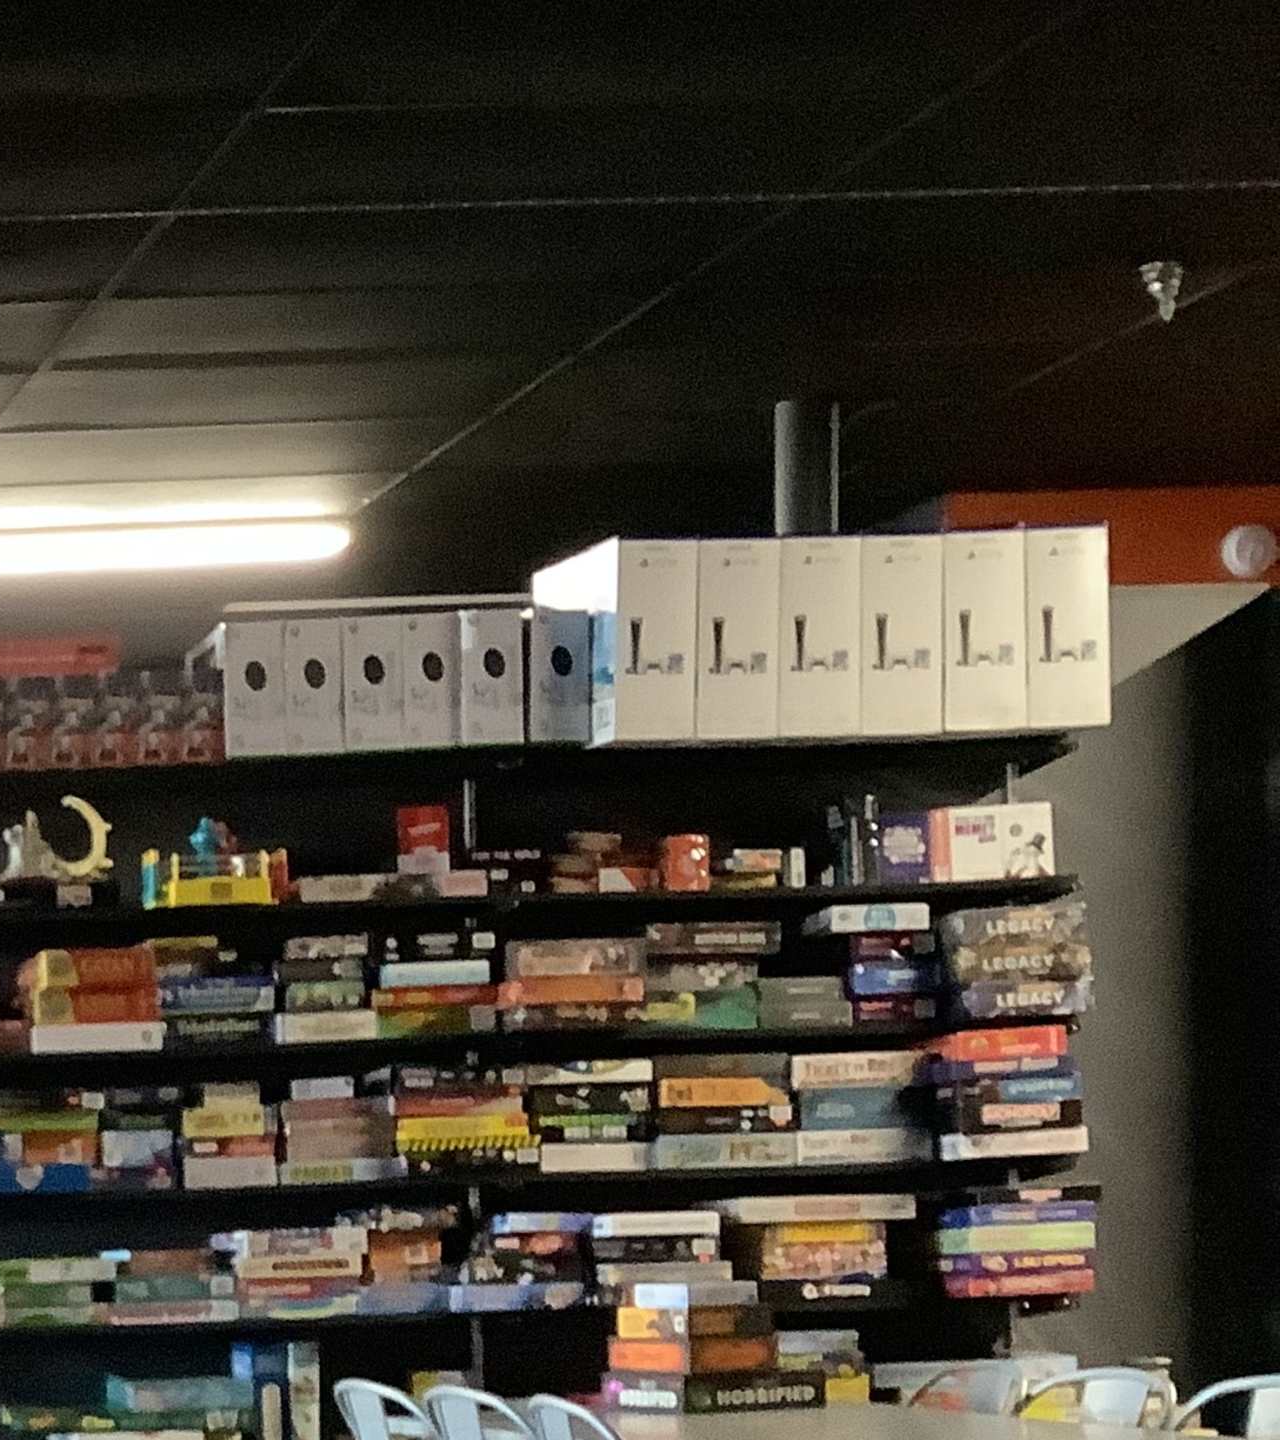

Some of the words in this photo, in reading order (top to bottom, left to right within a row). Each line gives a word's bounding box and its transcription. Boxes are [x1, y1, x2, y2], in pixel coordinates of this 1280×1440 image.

[986, 916, 1056, 935] LEGACY
[982, 953, 1056, 971] LEGACY
[996, 990, 1065, 1008] LEGACY
